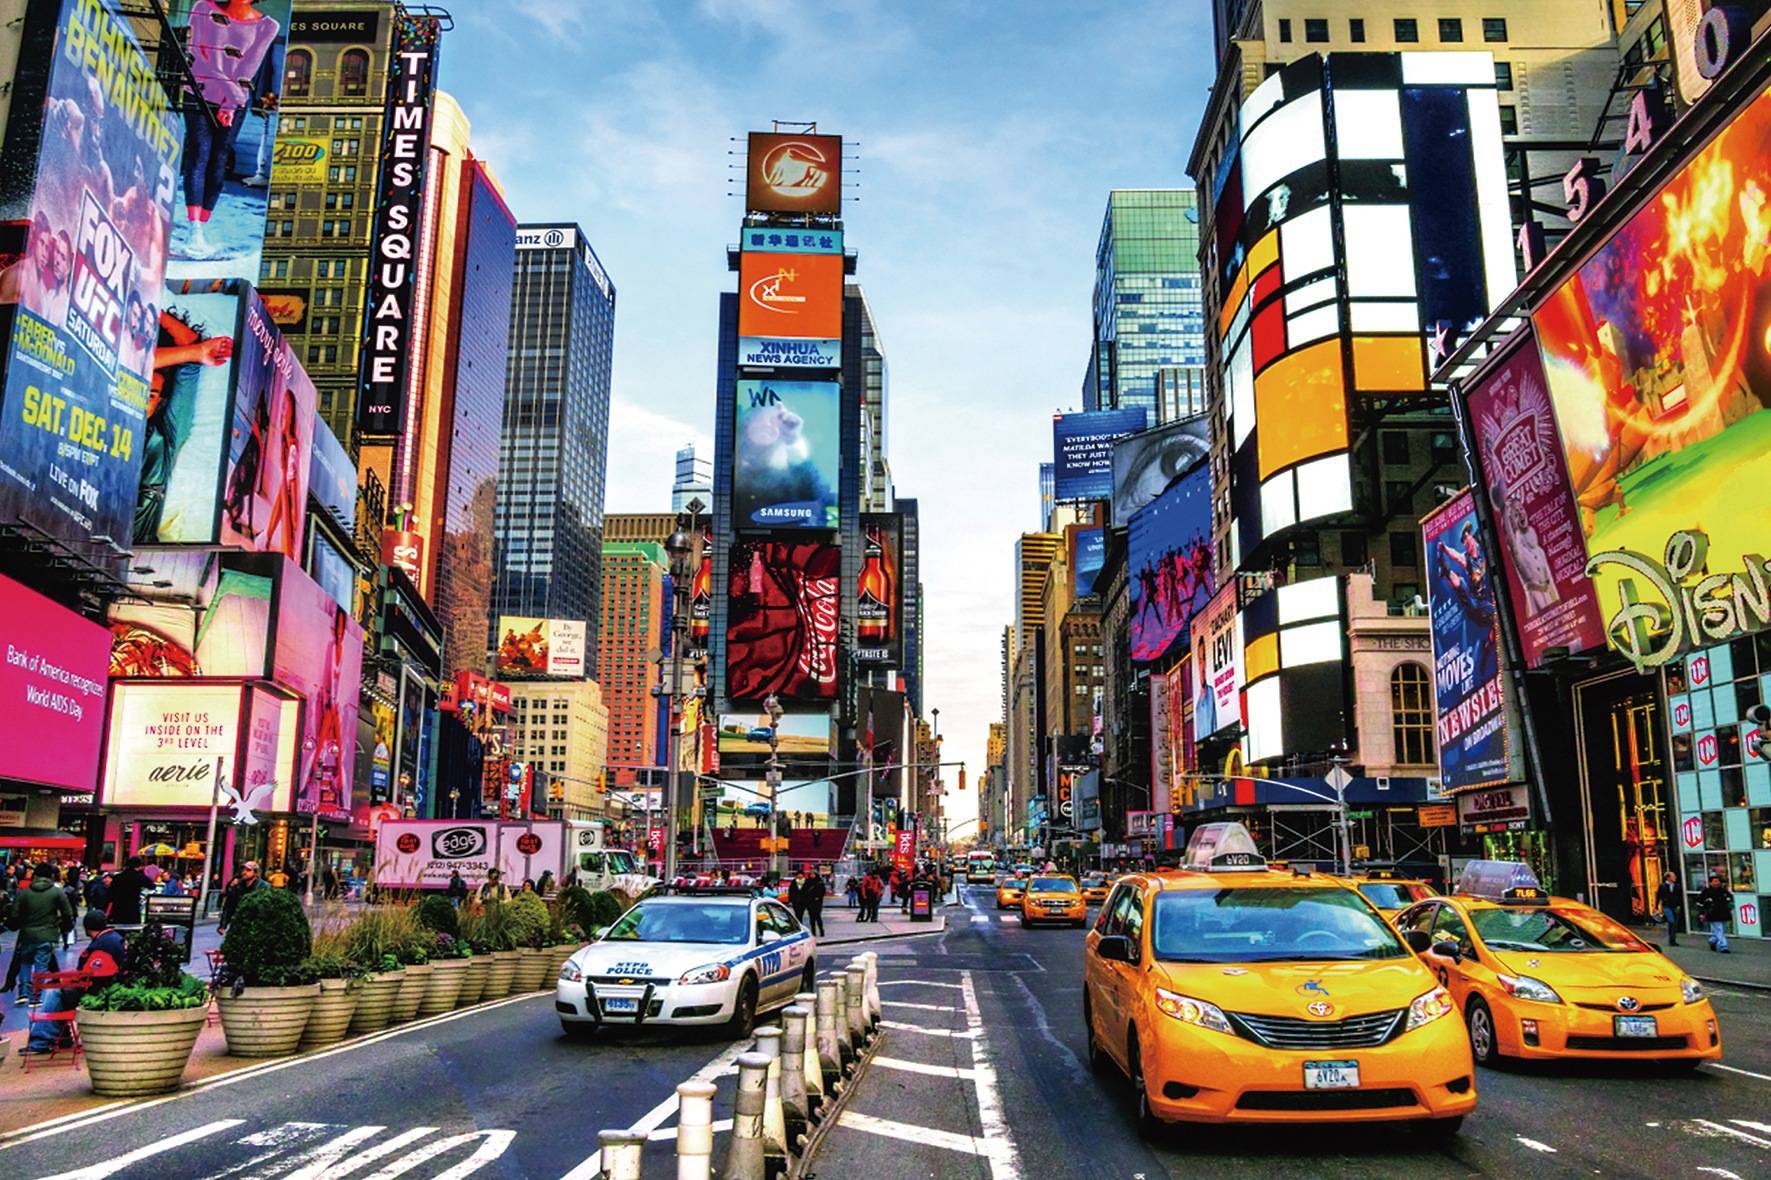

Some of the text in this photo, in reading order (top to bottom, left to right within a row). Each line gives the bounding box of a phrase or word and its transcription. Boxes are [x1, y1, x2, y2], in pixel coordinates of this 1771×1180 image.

[311, 22, 365, 31] SQUARE
[392, 52, 428, 188] TIMES
[155, 163, 176, 223] 2
[79, 195, 131, 303] FOX
[515, 235, 541, 245] anz
[751, 233, 833, 248] 新华通讯社
[372, 205, 411, 383] SQUARE
[74, 265, 122, 344] UFC
[20, 314, 55, 344] FABER
[68, 307, 118, 373] SATURDAY
[760, 341, 820, 355] XINHUA
[17, 333, 75, 376] McDONALD
[747, 353, 834, 366] NEWS AGENCY
[369, 405, 392, 414] NYC
[22, 385, 65, 436] SAT.
[68, 405, 107, 453] DEC.
[110, 423, 132, 462] 14
[1063, 443, 1096, 452] MATILDA
[1501, 425, 1532, 464] GREAT
[1066, 461, 1091, 469] KNOW
[1068, 451, 1106, 460] THEY JUST
[1504, 441, 1538, 484] COMET
[49, 462, 68, 488] LIVE
[68, 478, 79, 497] ON
[79, 478, 99, 511] FOX
[760, 508, 812, 518] SAMSUNG
[1213, 627, 1233, 673] LEVI
[1377, 637, 1431, 649] THE SHO
[7, 644, 104, 698] Bank of America recognizes
[1437, 646, 1474, 698] MOVES
[1461, 675, 1474, 696] LIKE
[26, 683, 50, 708] World
[50, 692, 68, 714] AIDS
[162, 712, 209, 723] VISIT US
[145, 725, 224, 736] INSIDE ON THE
[178, 737, 209, 749] LEVEL
[148, 758, 210, 782] aerie
[1509, 821, 1526, 830] SONY
[443, 835, 475, 851] edge
[650, 830, 662, 850] tkts
[900, 832, 912, 854] tkts
[446, 861, 489, 870] 947-3343
[1515, 888, 1537, 898] 7L66
[606, 967, 653, 976] POLICE
